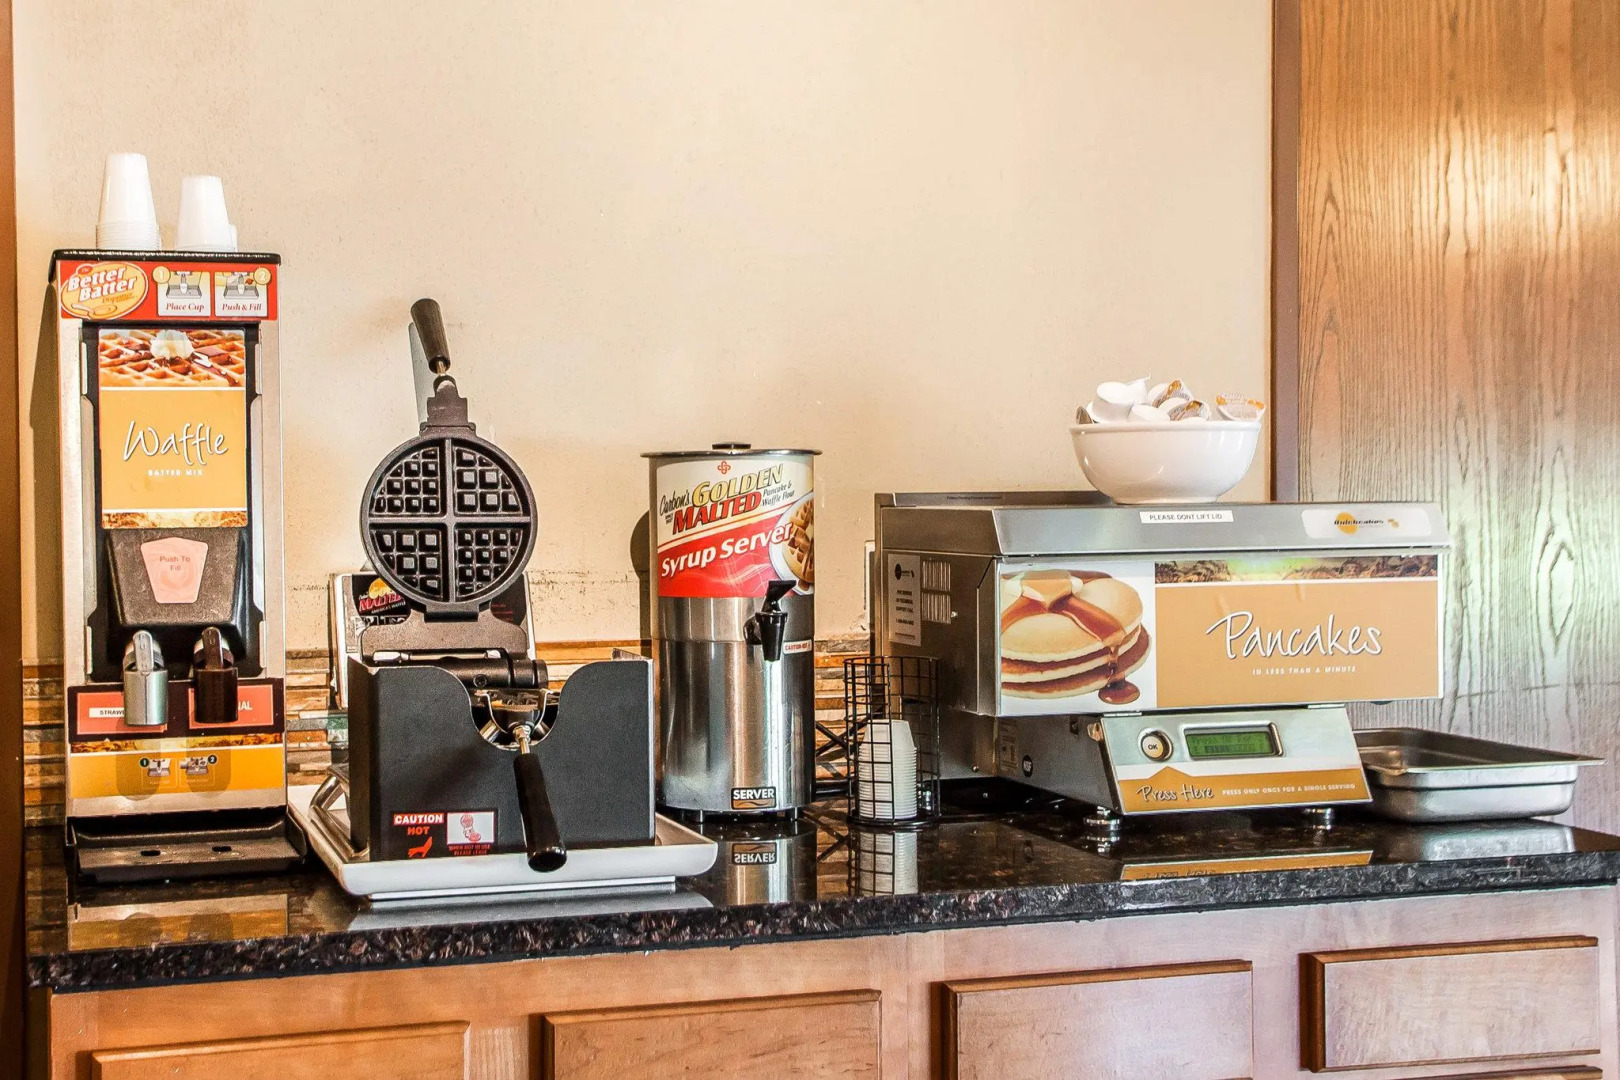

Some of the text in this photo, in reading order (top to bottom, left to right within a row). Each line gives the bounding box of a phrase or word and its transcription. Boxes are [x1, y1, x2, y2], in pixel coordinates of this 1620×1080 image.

[67, 265, 128, 292] Better
[159, 270, 165, 279] 1
[259, 271, 266, 281] 2
[78, 276, 138, 302] Batter
[166, 303, 205, 312] Place Cup
[222, 303, 241, 311] Push
[249, 303, 262, 311] Fill
[123, 420, 229, 466] Waffle
[185, 469, 203, 477] MIX
[692, 463, 784, 508] GOLDEN
[762, 483, 787, 497] Pancake
[762, 494, 781, 507] Waffle
[672, 491, 762, 535] MALTED
[661, 522, 794, 578] Syrup Server
[159, 555, 179, 563] Push
[1205, 611, 1383, 660] Pancakes
[1265, 667, 1285, 675] LESS
[1288, 666, 1311, 675] THAN
[1324, 665, 1356, 673] MINUTE
[1147, 743, 1158, 751] OK
[733, 788, 775, 800] SERVER
[1136, 783, 1214, 802] Press Here
[394, 814, 443, 825] CAUTION
[407, 826, 430, 836] HOT
